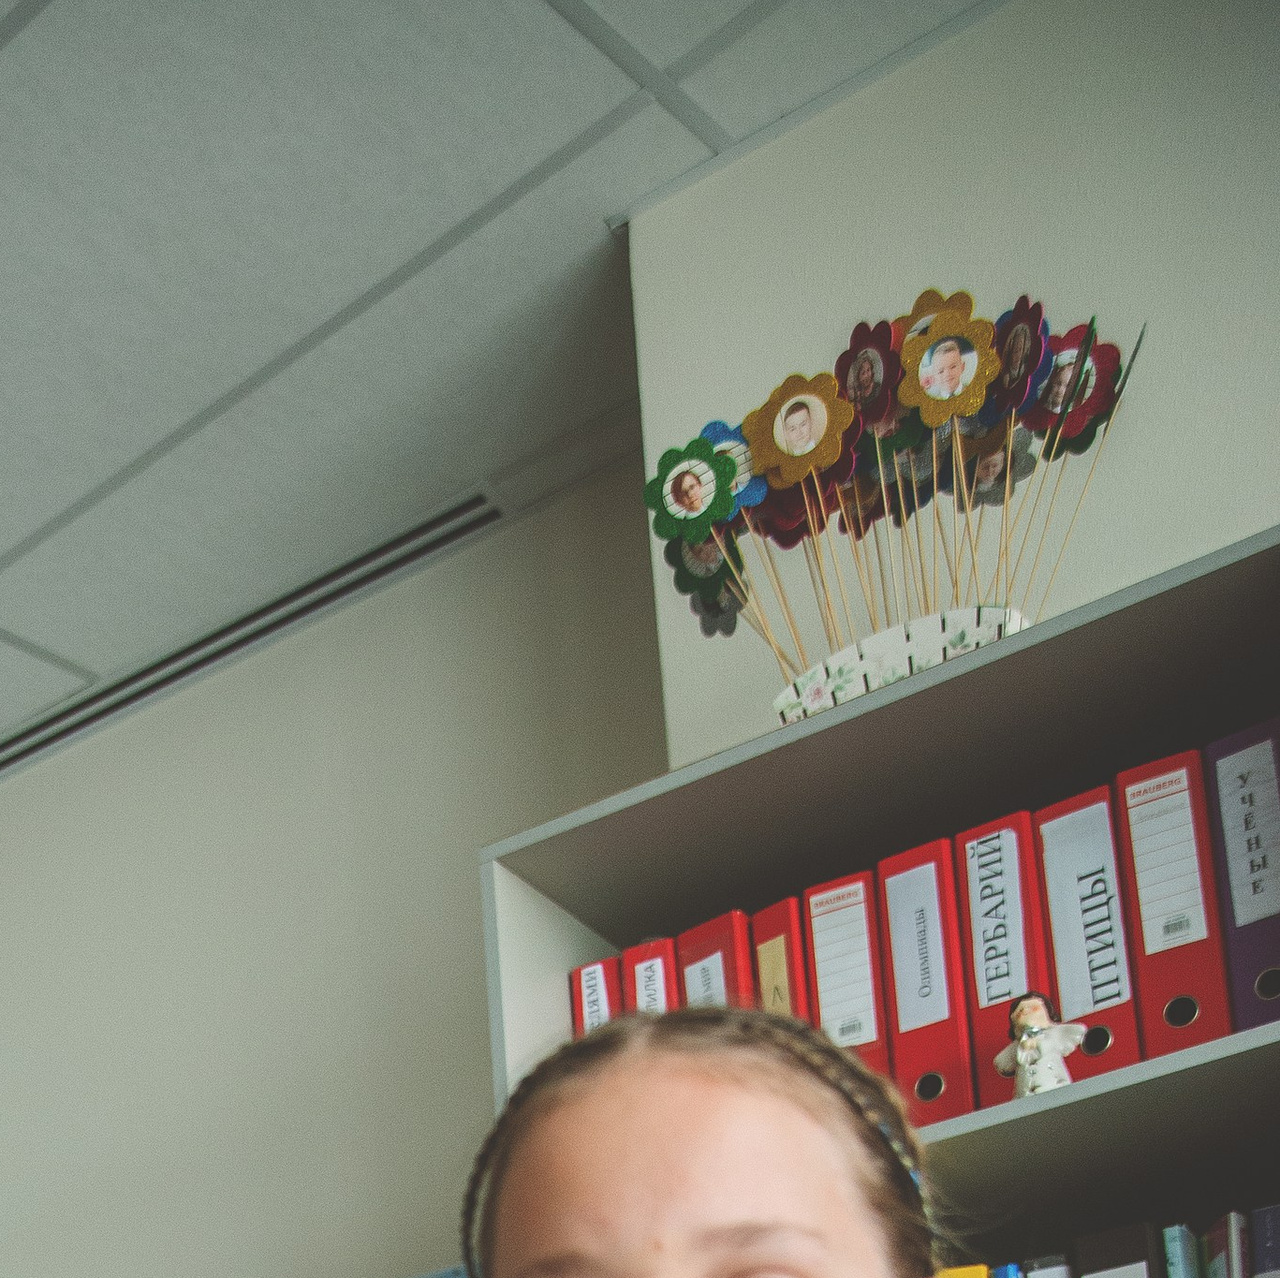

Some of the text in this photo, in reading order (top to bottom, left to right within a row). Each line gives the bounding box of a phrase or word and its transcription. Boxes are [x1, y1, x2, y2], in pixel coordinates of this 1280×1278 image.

[1129, 777, 1183, 800] BRAUBERG
[1236, 771, 1269, 897] УЧЁНЫЕ
[813, 886, 860, 910] BRAUBERG
[970, 831, 1013, 1005] ГЕРБАРИЙ
[1076, 864, 1122, 1008] ПТИЦЫ
[915, 908, 932, 999] Олимпиады
